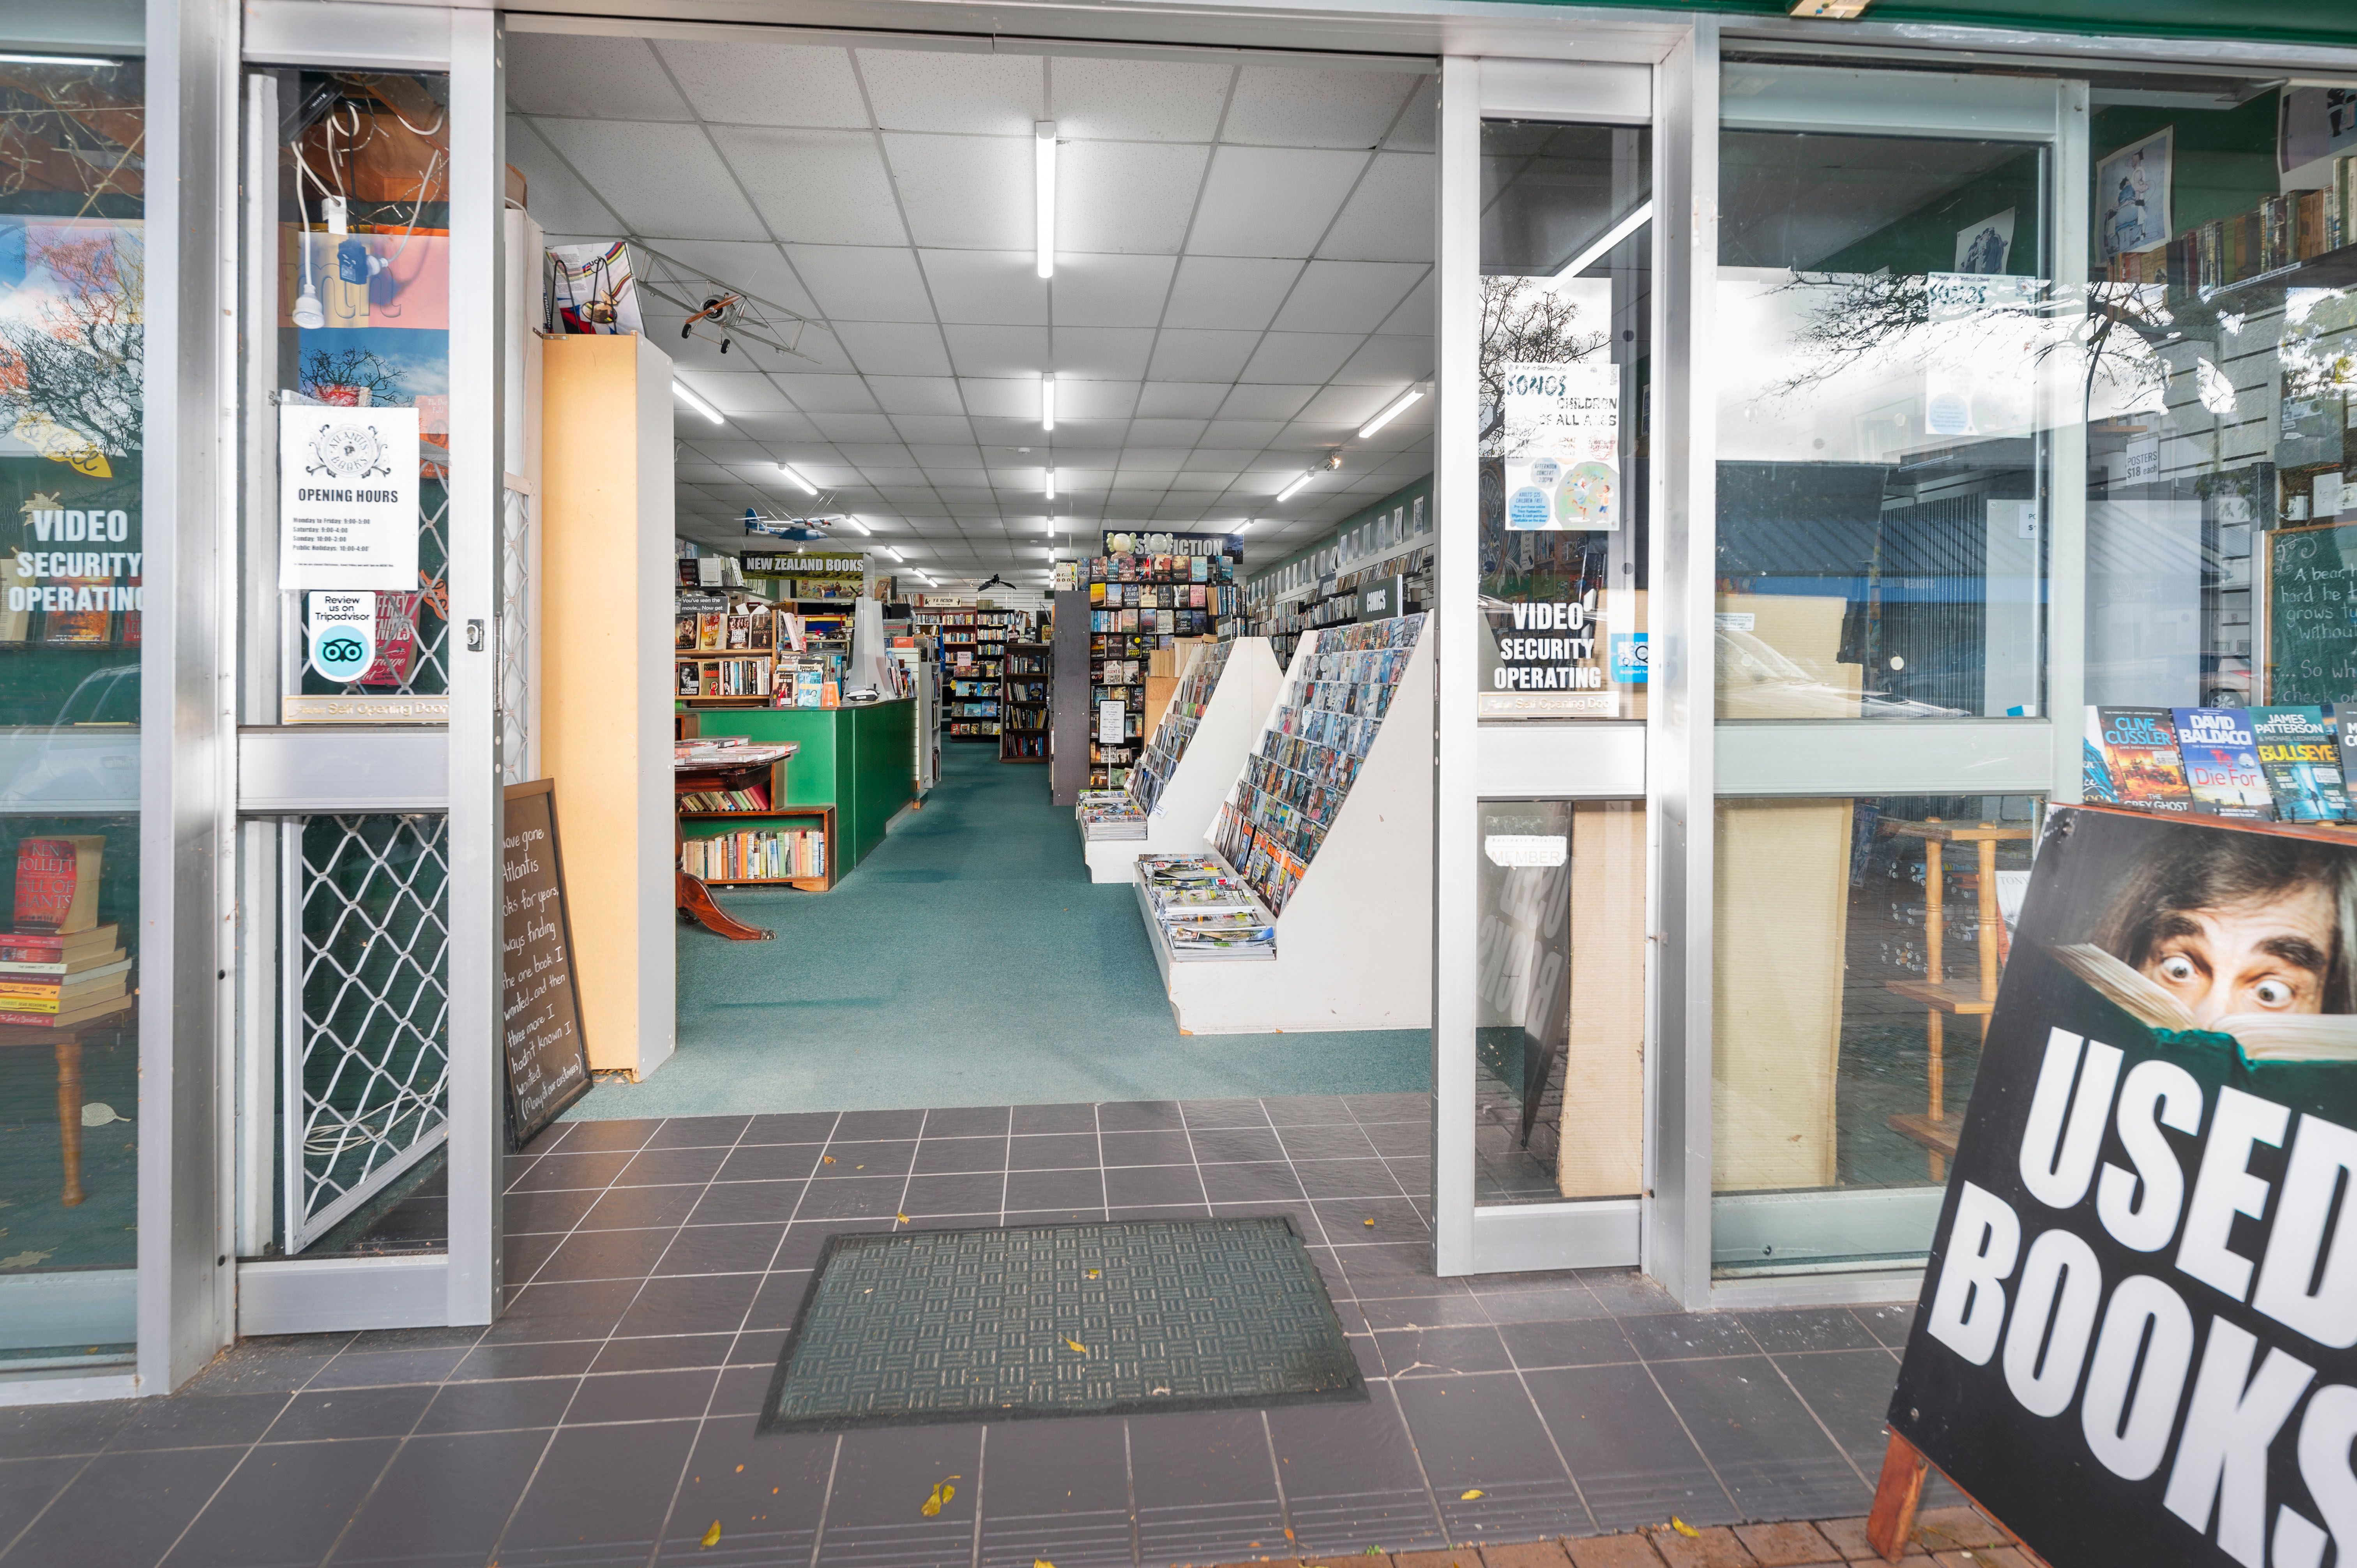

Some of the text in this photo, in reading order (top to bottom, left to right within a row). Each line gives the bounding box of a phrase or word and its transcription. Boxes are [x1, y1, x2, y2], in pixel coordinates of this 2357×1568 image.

[1557, 414, 1579, 426] ALL
[329, 431, 368, 450] ATLANTIS
[331, 457, 368, 471] BOOKS
[2127, 451, 2157, 467] POSTERS
[2127, 464, 2157, 478] $18 each
[299, 488, 398, 503] OPENING HOURS
[33, 510, 128, 542] VIDEO
[1166, 539, 1223, 556] ICTION
[17, 552, 143, 577] SECURITY
[747, 558, 864, 572] NEW ZEALAND BOOKS
[2294, 568, 2306, 581] A
[325, 596, 360, 604] Review
[1367, 589, 1386, 613] COMICS
[2281, 583, 2341, 603] hard he
[315, 613, 370, 622] Tripadvisor
[1512, 602, 1583, 630] VIDEO
[2286, 607, 2334, 627] grows
[1500, 638, 1595, 660] SECURITY
[2300, 659, 2322, 678] So
[1494, 667, 1601, 689] OPERATING
[2283, 684, 2333, 703] check
[328, 703, 354, 715] Self
[357, 703, 412, 716] Opening
[415, 703, 448, 714] Door
[1515, 698, 1585, 710] Self Opening
[2115, 717, 2157, 731] CLIVE
[2189, 715, 2235, 730] DAVID
[2267, 714, 2306, 724] JAMES
[2254, 724, 2324, 733] PATTERSON
[2105, 730, 2173, 745] CUSSLER
[2179, 729, 2253, 745] BALDACCI
[2210, 749, 2233, 768] To
[2258, 745, 2336, 761] BULLSEYE
[2195, 768, 2226, 785] Die
[2228, 769, 2258, 786] For
[2153, 801, 2188, 811] GHOST
[522, 828, 544, 852] gone
[32, 843, 59, 856] KEN
[1492, 851, 1560, 864] MEMBER
[18, 856, 75, 872] FOLLETT
[17, 878, 75, 893] FALL OF
[16, 893, 71, 909] GIANTS
[521, 888, 537, 910] for
[503, 916, 556, 956] lways finding
[518, 946, 563, 982] one book I
[549, 973, 565, 989] then
[507, 1003, 555, 1048] three more I
[511, 1021, 572, 1075] hadn't known I
[541, 1081, 556, 1099] of our
[2019, 1026, 2357, 1348] USED
